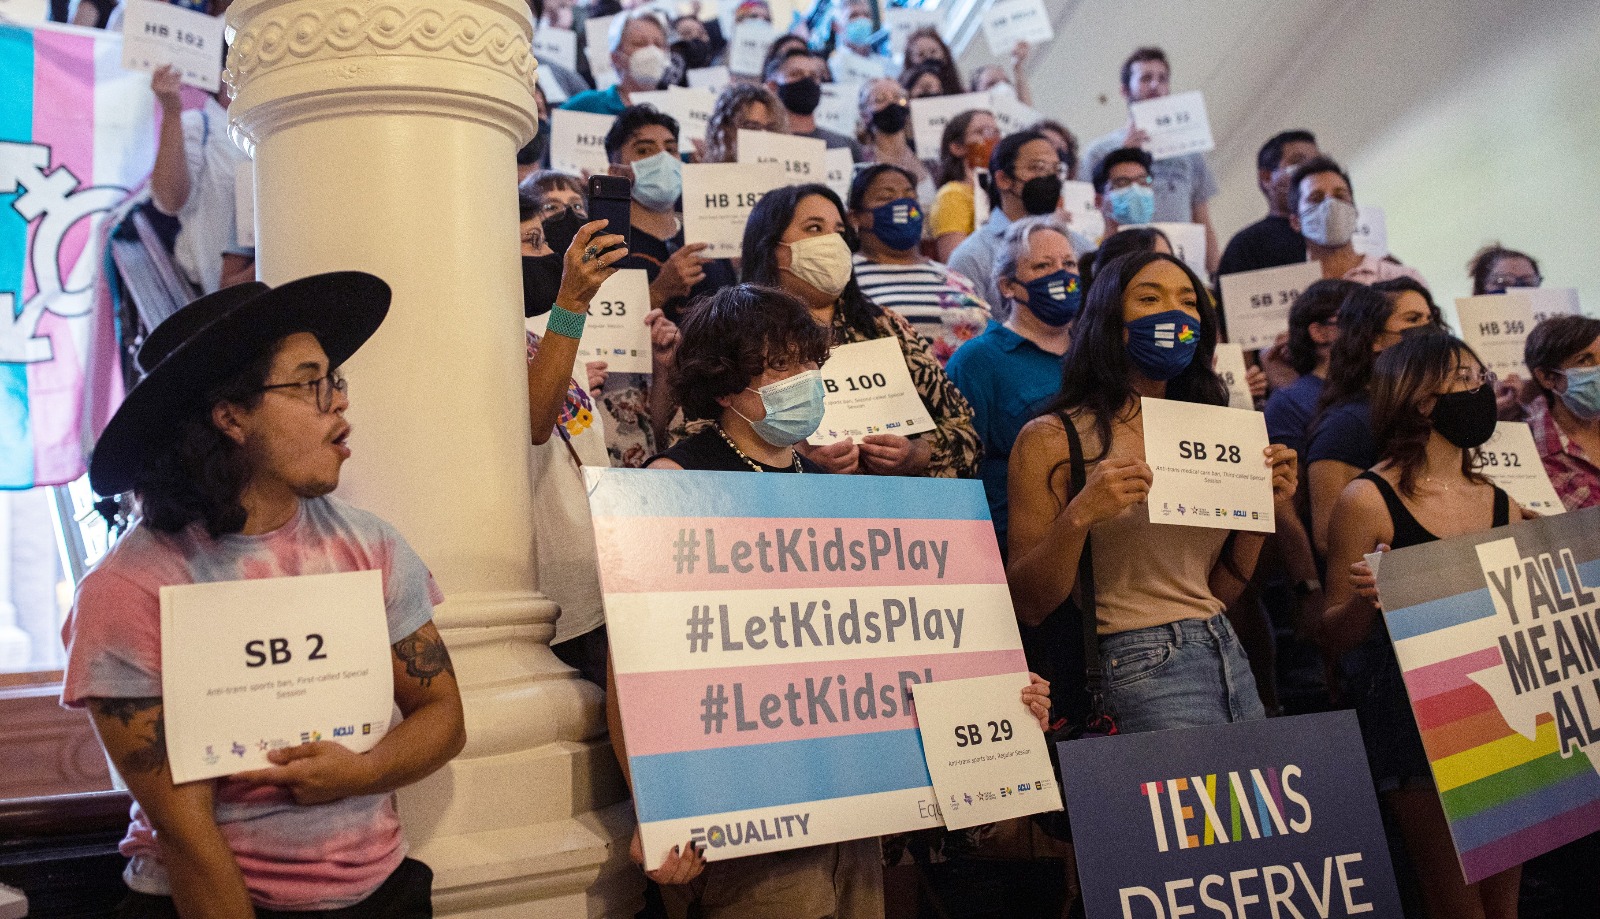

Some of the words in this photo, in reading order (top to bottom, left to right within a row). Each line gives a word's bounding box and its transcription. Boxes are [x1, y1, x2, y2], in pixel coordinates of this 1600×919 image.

[785, 160, 810, 174] 185
[705, 193, 728, 208] HB
[600, 301, 626, 316] 33
[1250, 293, 1272, 309] SB
[1479, 321, 1500, 336] HB
[1504, 320, 1525, 335] 369
[824, 378, 839, 393] B
[846, 372, 887, 392] 100
[1179, 440, 1207, 461] SB
[1215, 444, 1242, 464] 28
[1480, 451, 1498, 466] SB
[1502, 452, 1521, 467] 32
[672, 527, 949, 578] #LetKidsPlay
[1487, 551, 1595, 625] Y'ALL
[686, 596, 965, 653] #LetKidsPlay
[245, 638, 292, 668] SB
[306, 633, 327, 661] 2
[1498, 606, 1600, 695] MEAN
[333, 726, 354, 737] ACLU
[954, 724, 982, 748] SB
[987, 719, 1013, 742] 29
[1018, 783, 1030, 792] ACLU
[1140, 764, 1312, 853] TEXANS
[690, 813, 810, 850] EQUALITY
[1119, 852, 1374, 919] DESERVE
